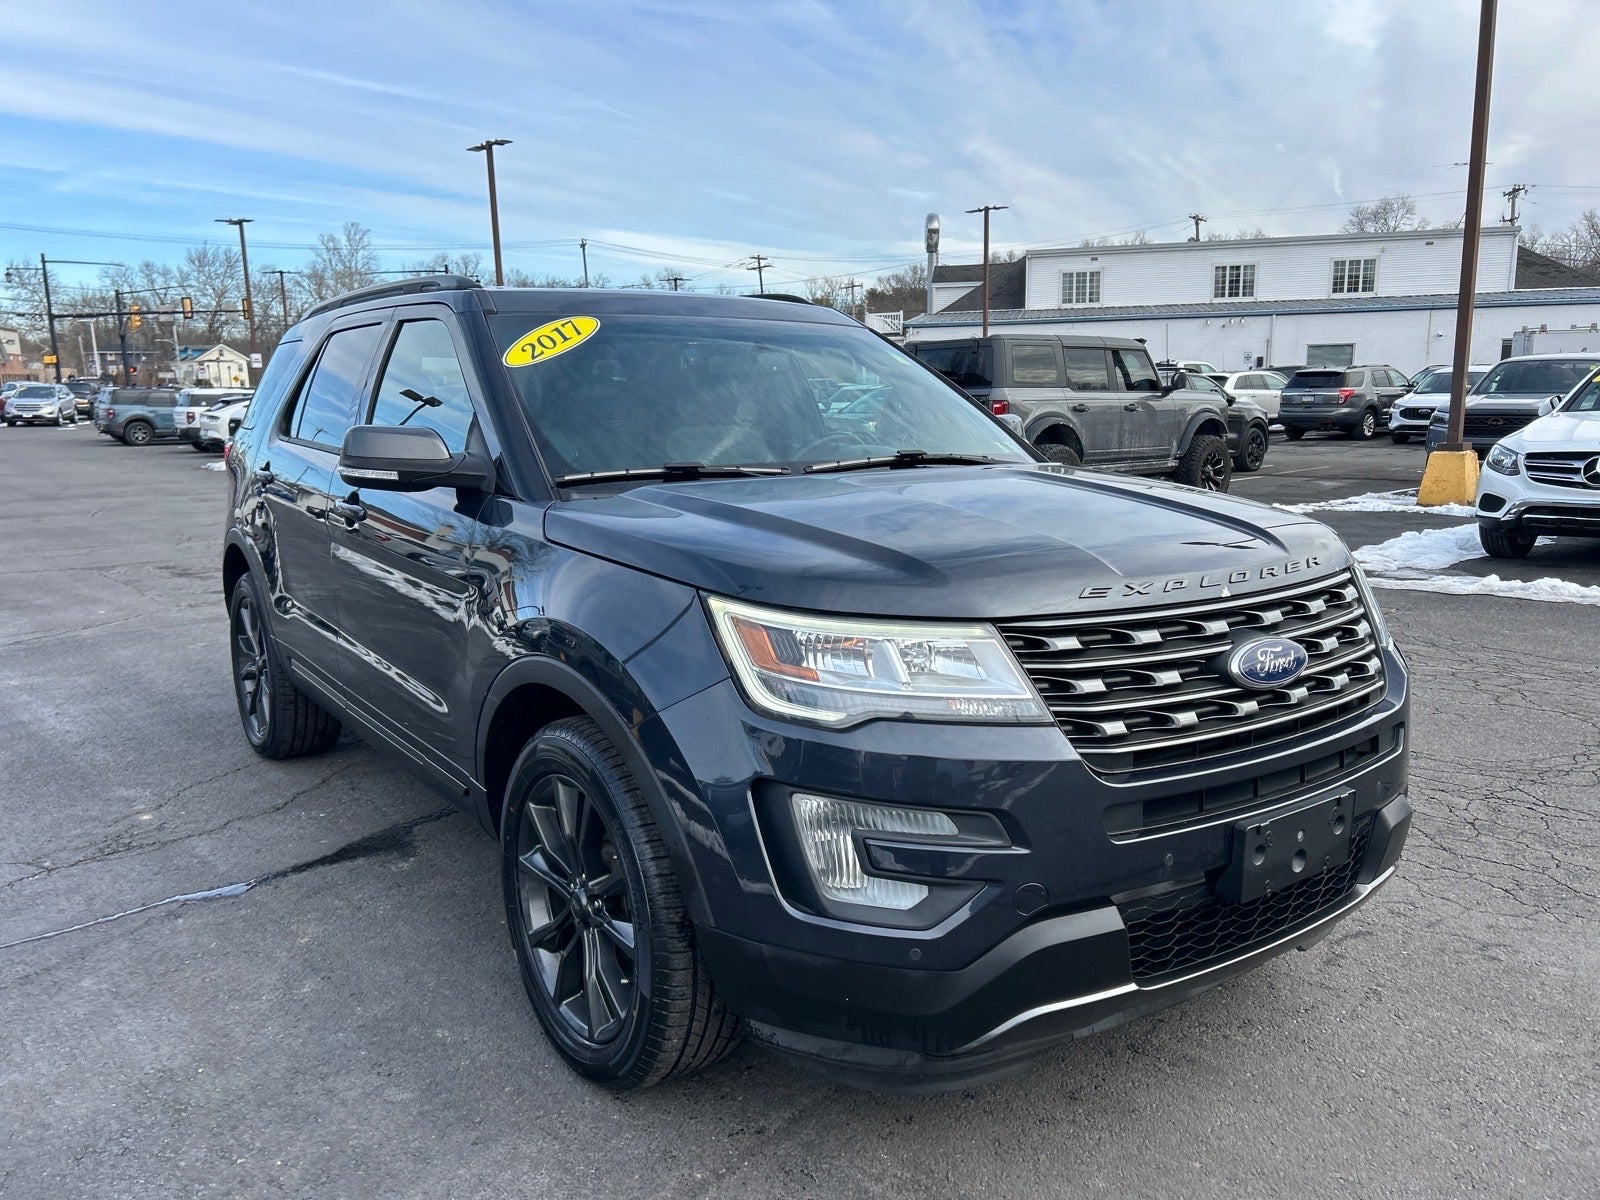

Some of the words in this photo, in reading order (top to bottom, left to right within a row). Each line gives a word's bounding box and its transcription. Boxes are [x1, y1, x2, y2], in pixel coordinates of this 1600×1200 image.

[521, 320, 582, 360] 2017
[1079, 556, 1322, 599] EXPLORER
[1257, 646, 1297, 676] Ford
